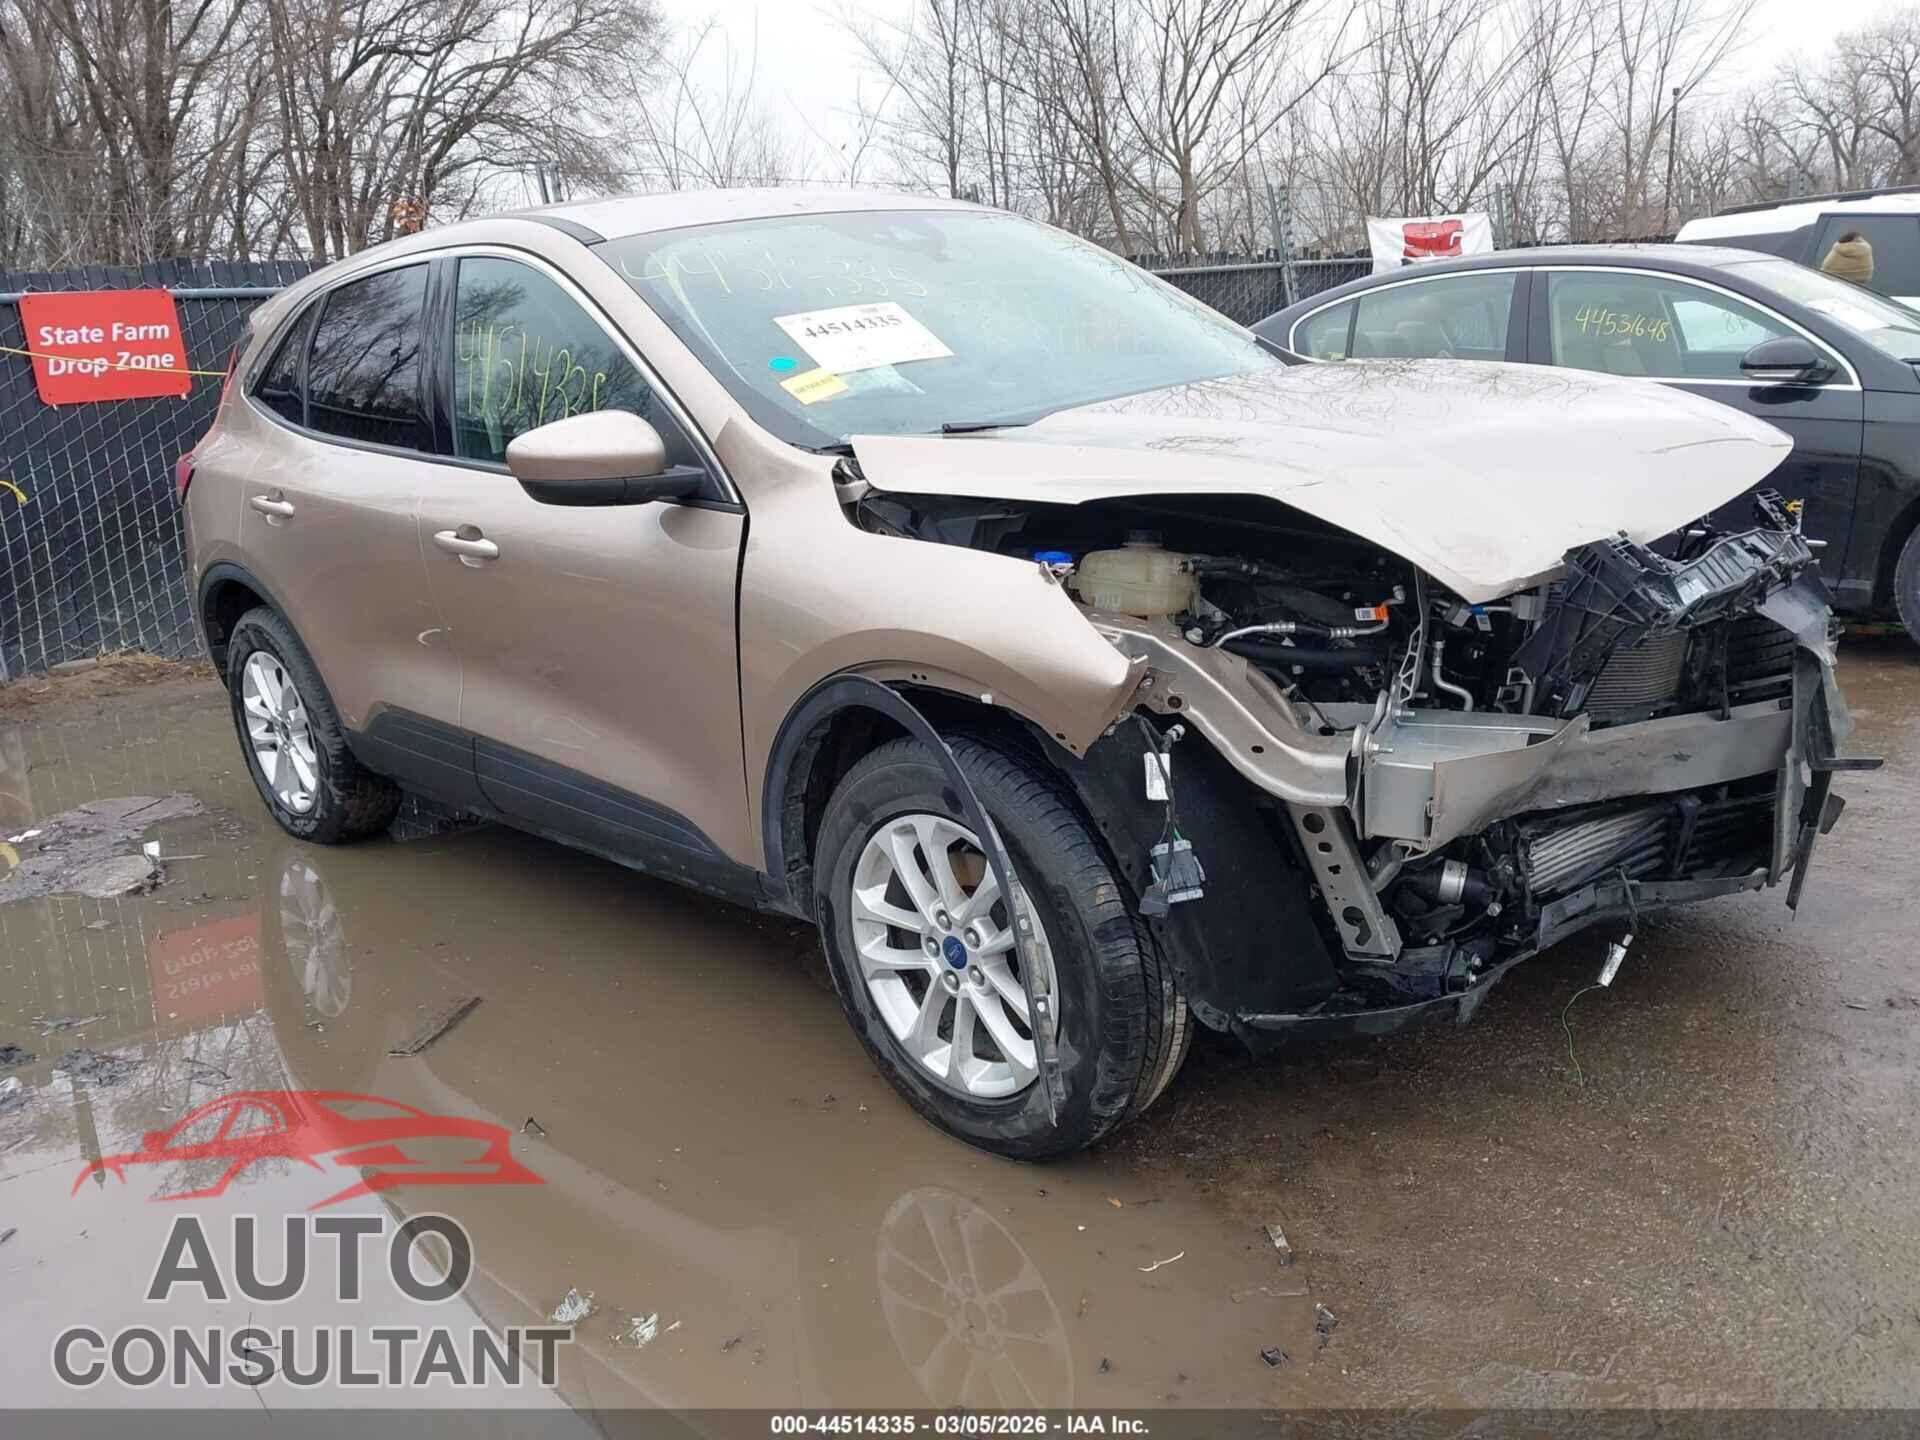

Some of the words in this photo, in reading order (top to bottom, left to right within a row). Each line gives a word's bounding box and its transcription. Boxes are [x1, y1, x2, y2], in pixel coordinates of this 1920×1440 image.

[39, 325, 104, 347] State
[111, 322, 170, 342] Farm
[804, 314, 903, 338] 44514335
[1575, 303, 1672, 343] 44531648
[48, 355, 109, 379] Drop
[116, 351, 175, 372] Zone
